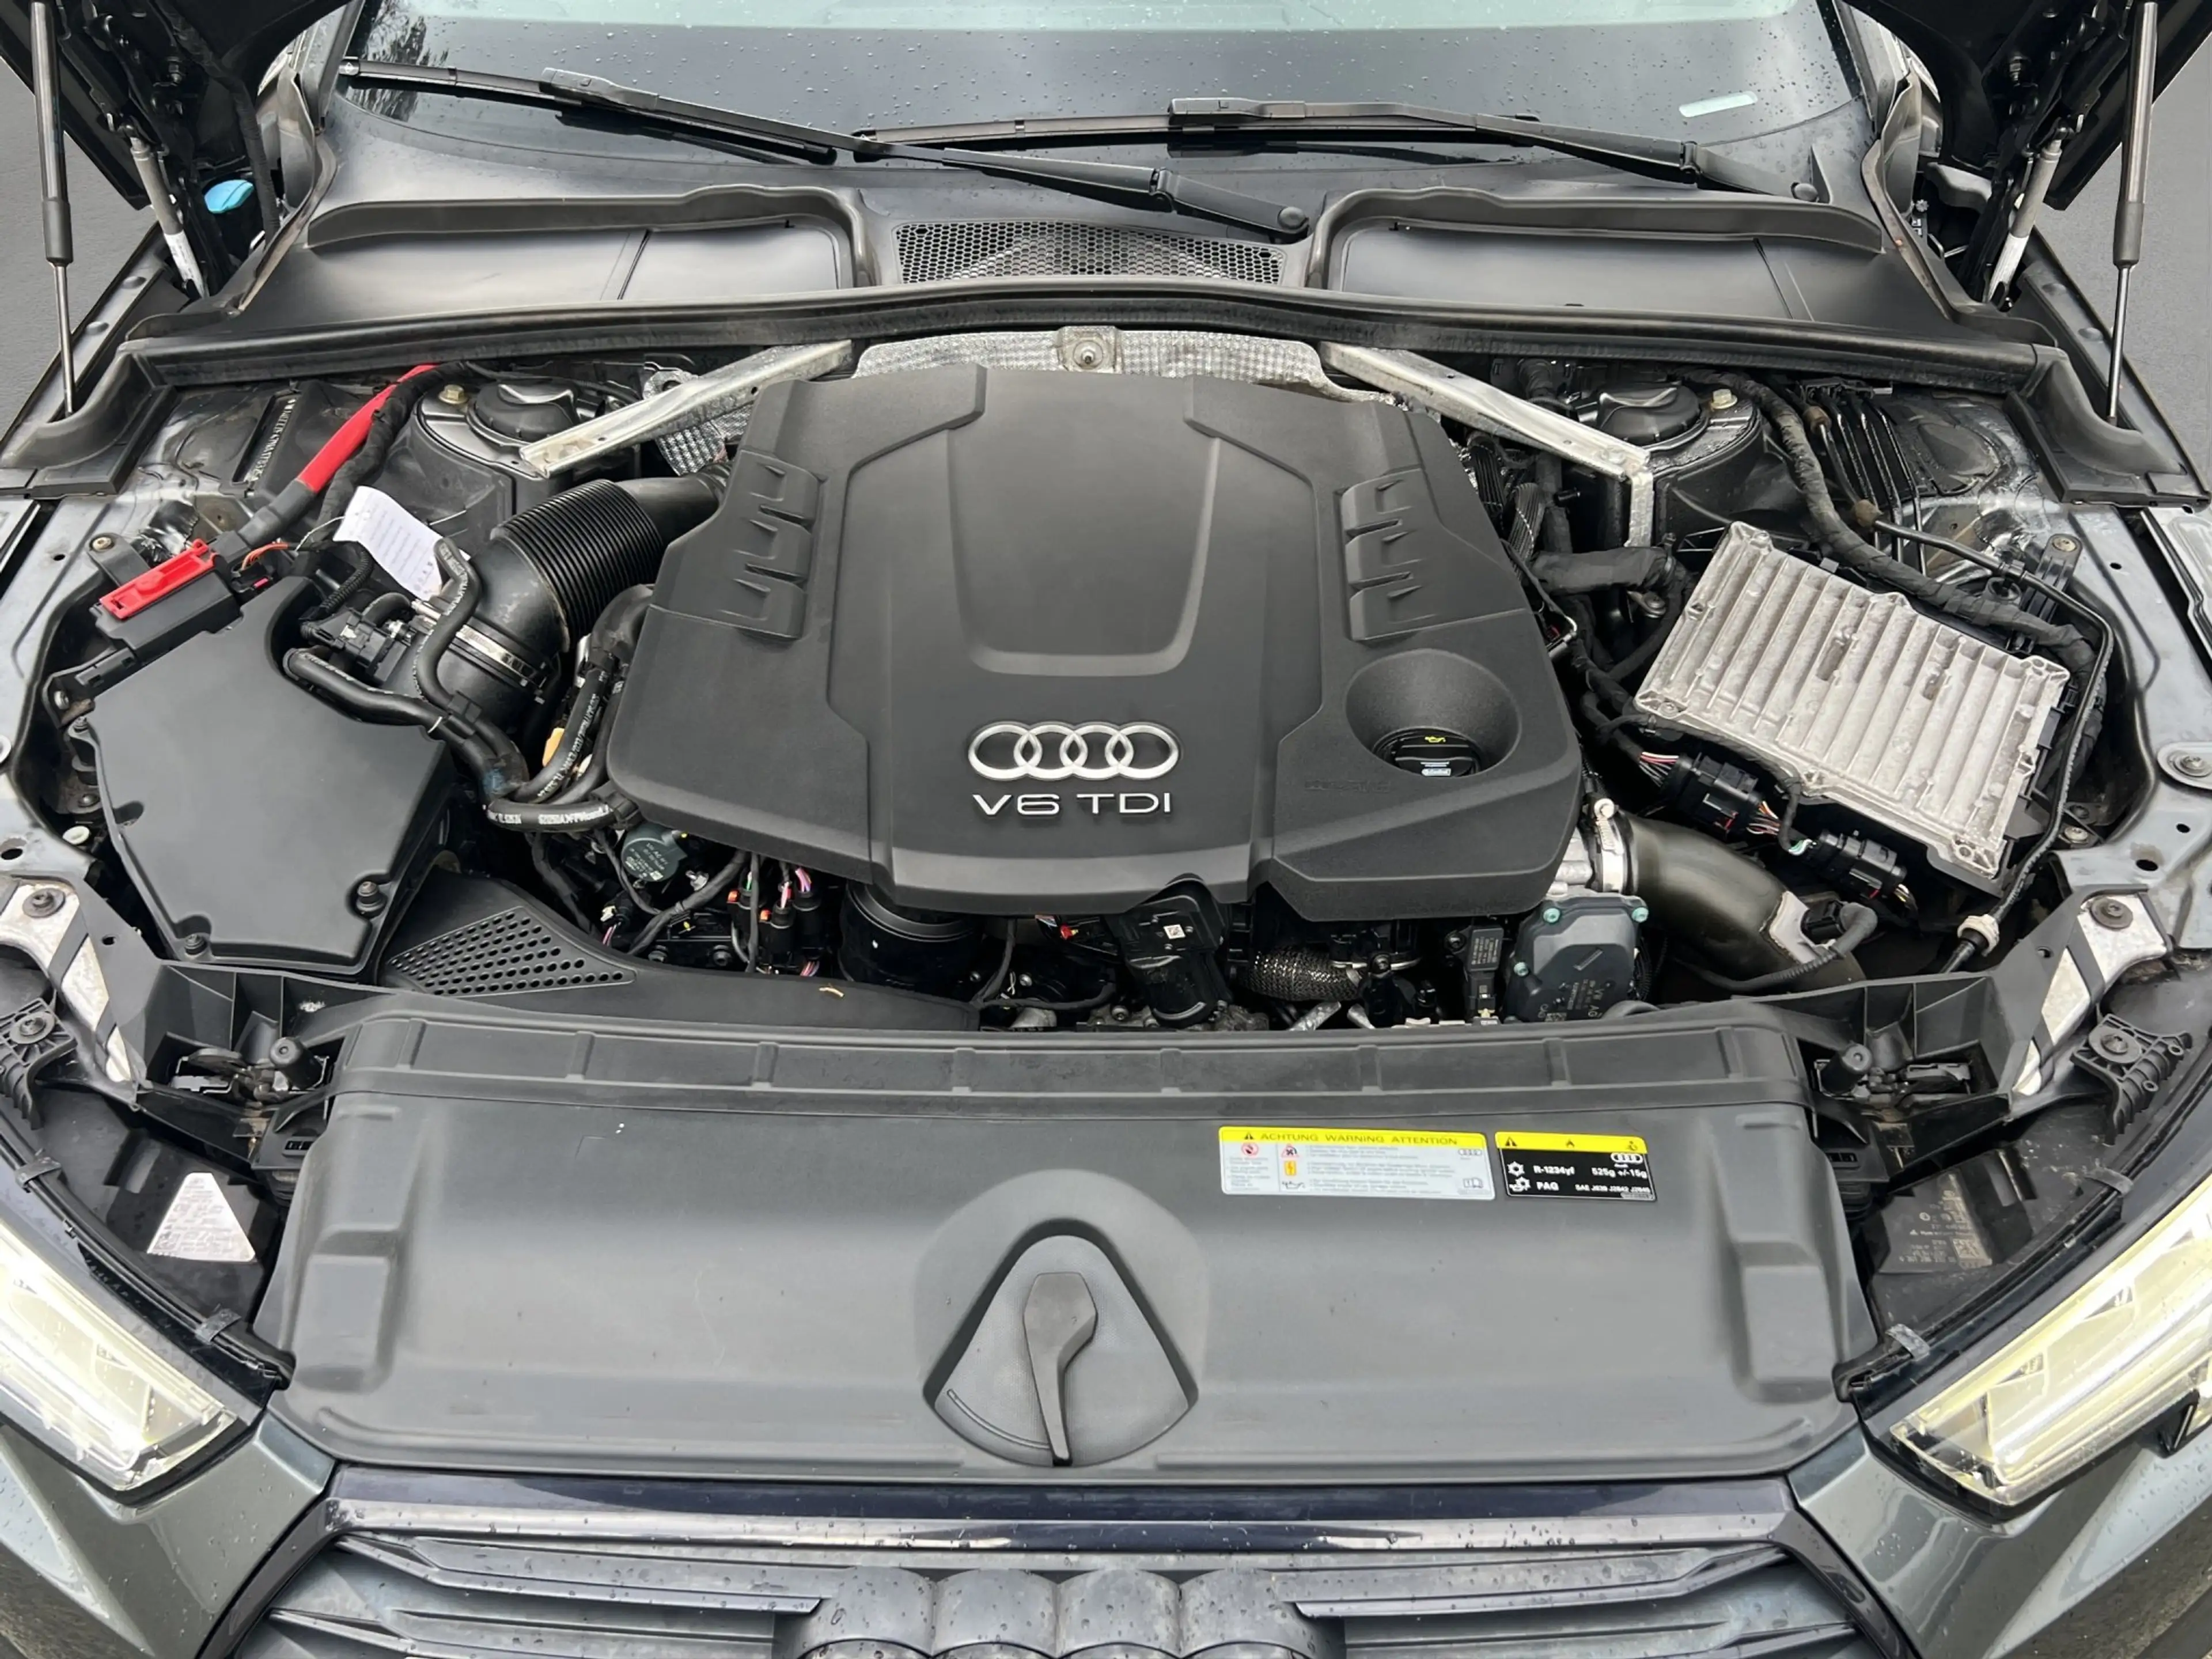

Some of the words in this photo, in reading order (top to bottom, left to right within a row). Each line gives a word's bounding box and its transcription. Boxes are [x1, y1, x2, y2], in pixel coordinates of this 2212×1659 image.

[972, 793, 1060, 815] V6
[1076, 792, 1171, 814] TDI
[1260, 1132, 1319, 1142] ACHTUNG
[1325, 1134, 1385, 1143] WARNING
[1391, 1135, 1458, 1145] ATTENTION
[1591, 1168, 1616, 1179] 525g
[1536, 1181, 1560, 1191] PAG
